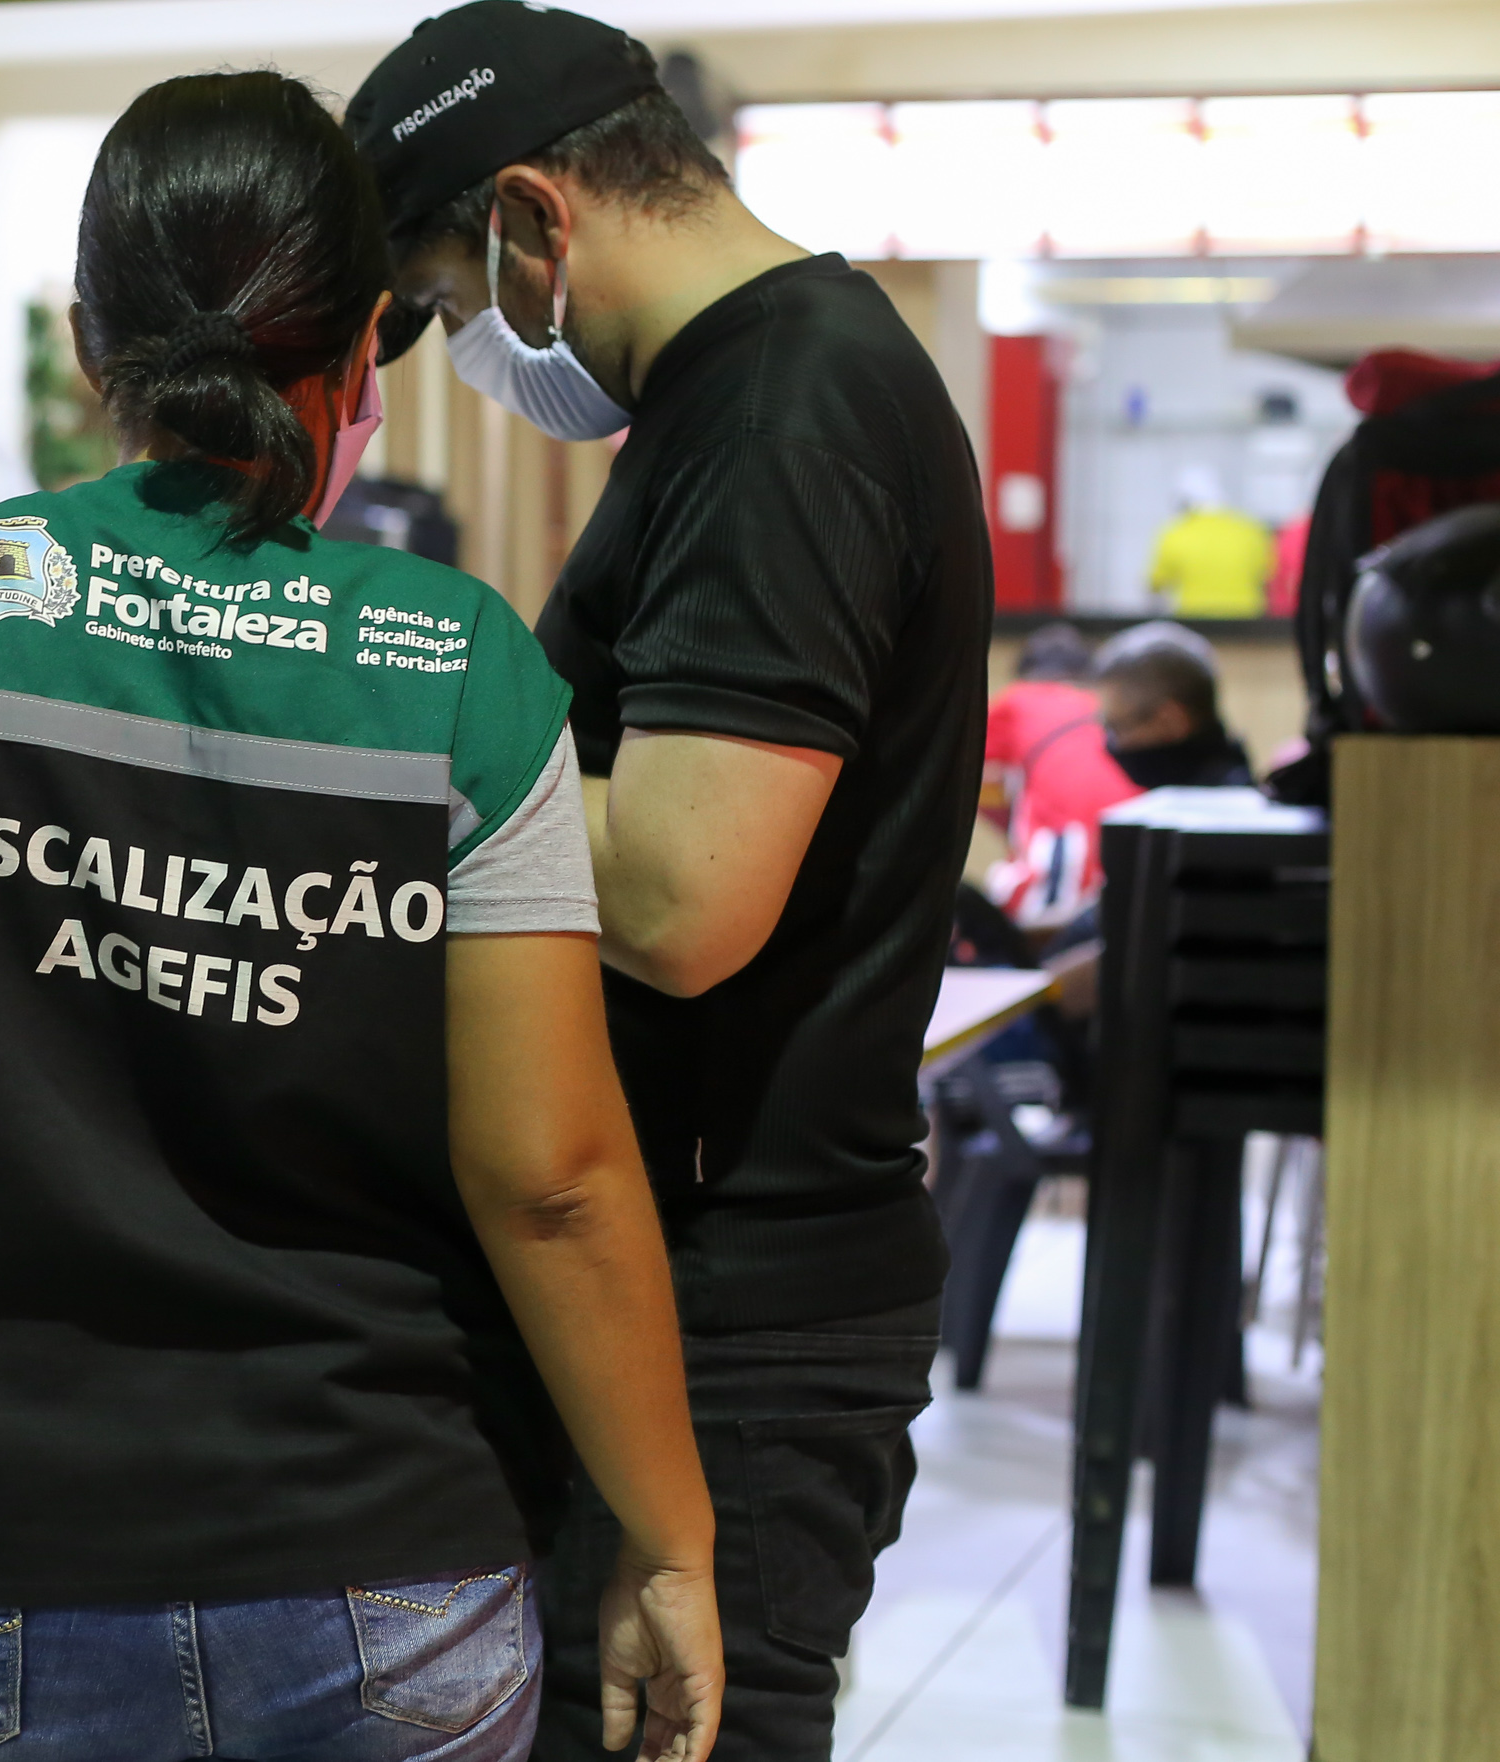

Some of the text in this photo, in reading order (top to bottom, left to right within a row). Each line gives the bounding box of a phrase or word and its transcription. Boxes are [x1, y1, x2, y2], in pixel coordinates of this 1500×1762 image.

[392, 68, 496, 143] FISCALIZAÇÃO
[90, 543, 332, 606] Prefeitura de
[85, 621, 233, 660] Gabinete do Prefeito
[86, 576, 328, 654] Fortaleza
[358, 605, 462, 632] Agência de
[356, 648, 381, 665] de
[358, 626, 467, 656] Fiscalização
[35, 918, 302, 1026] AGEFIS
